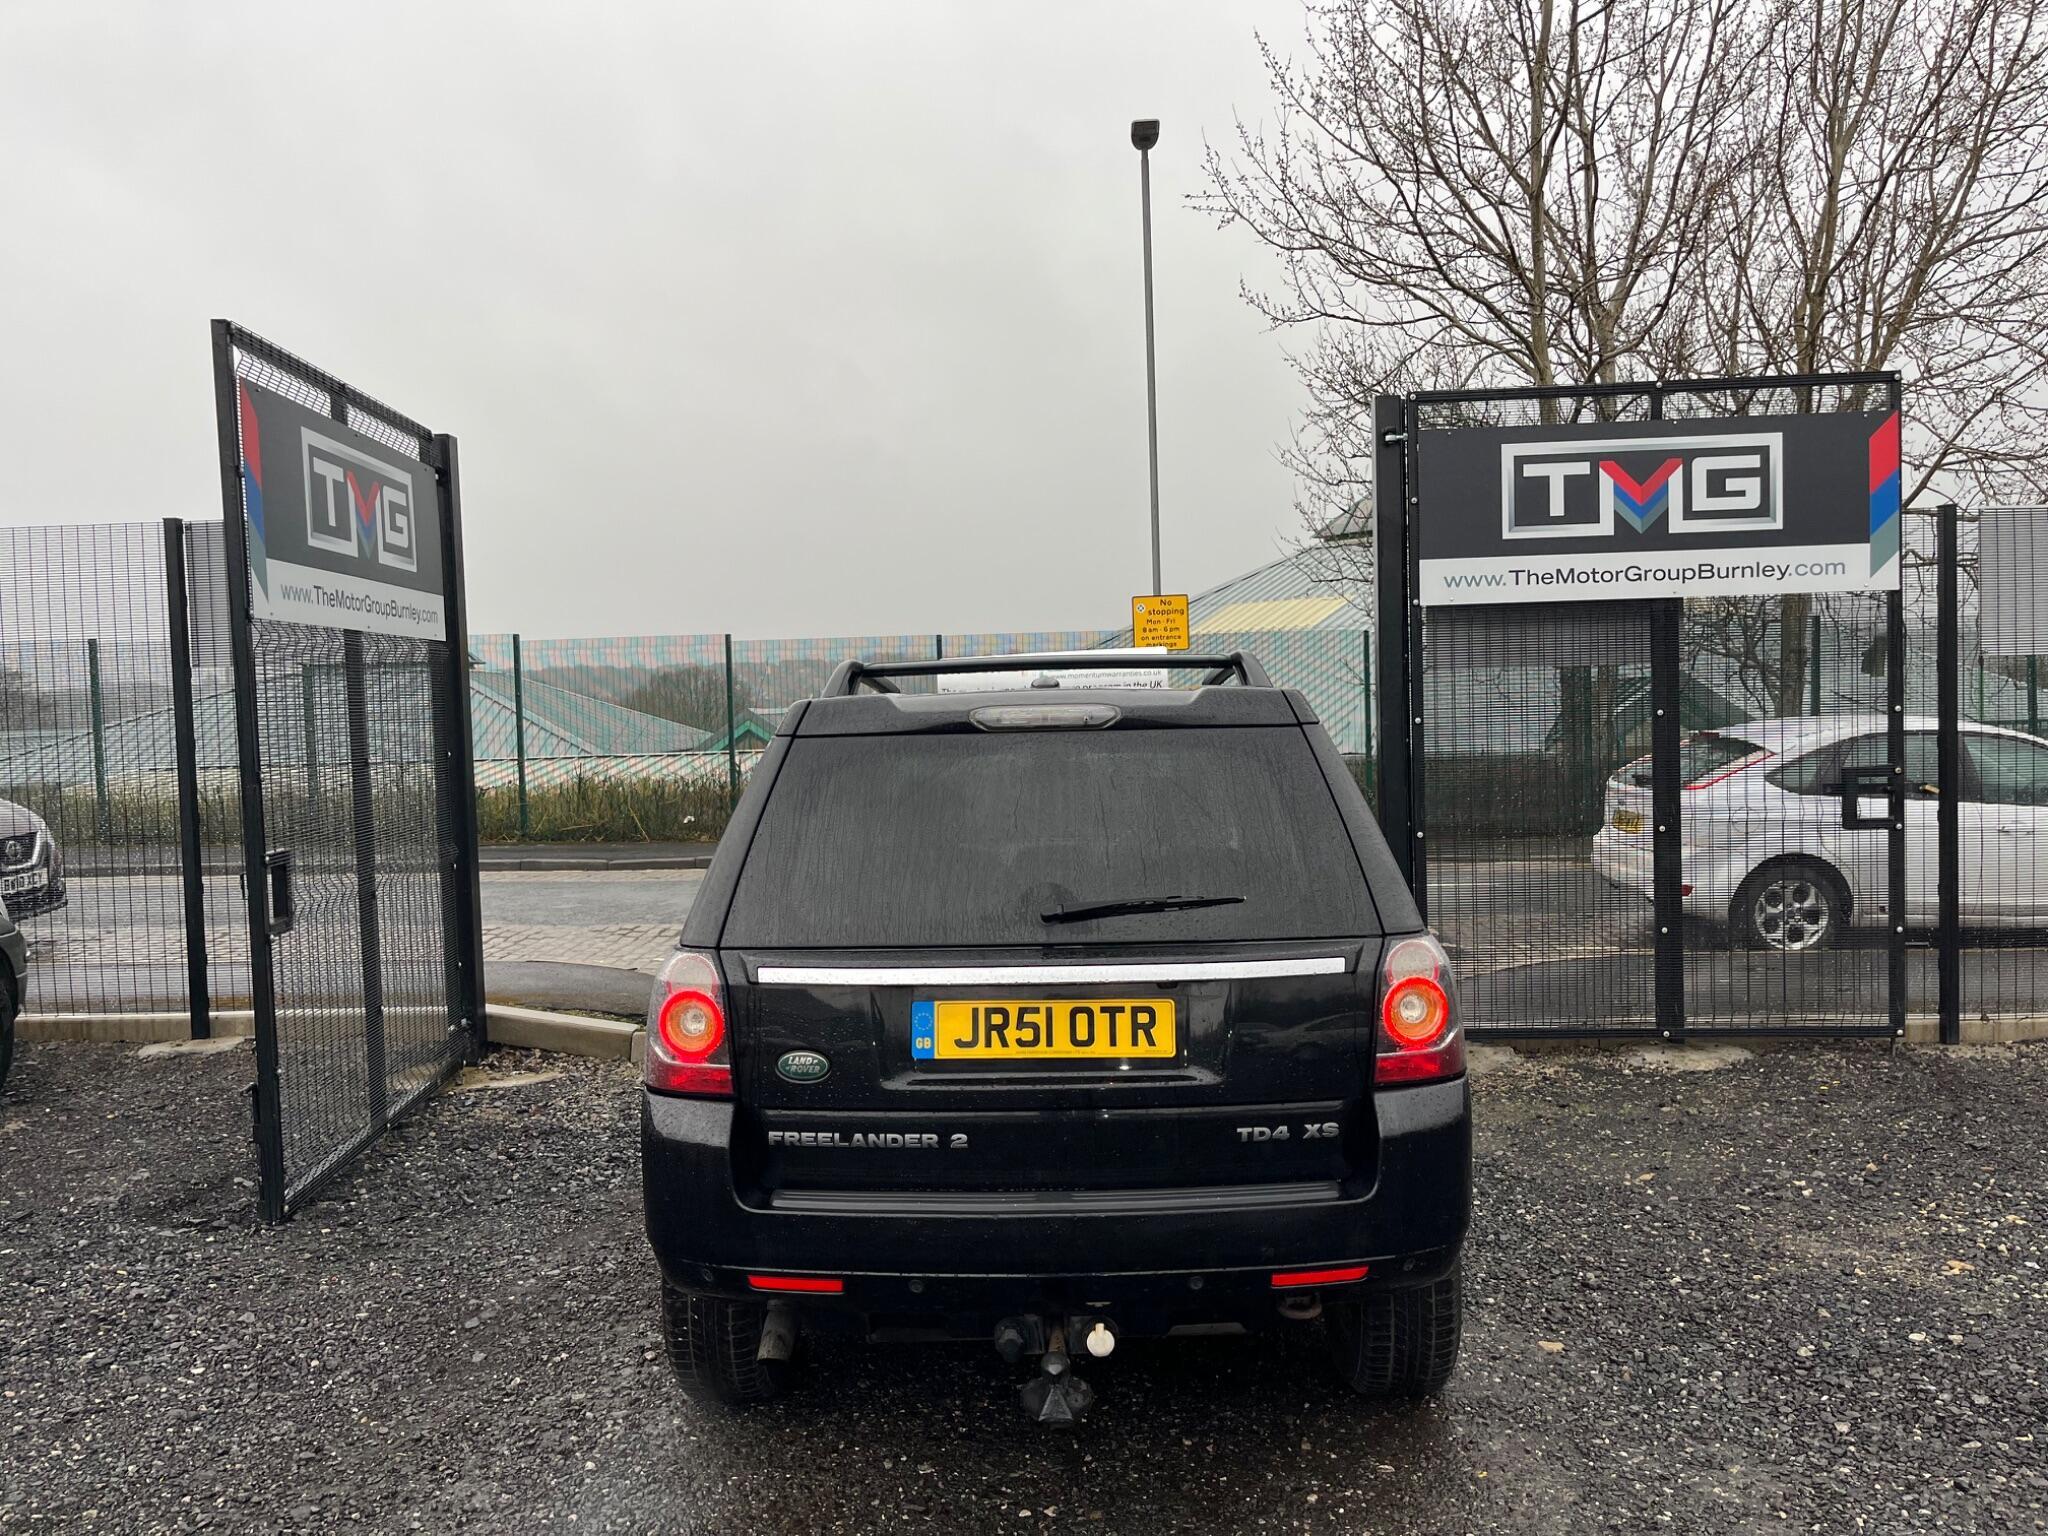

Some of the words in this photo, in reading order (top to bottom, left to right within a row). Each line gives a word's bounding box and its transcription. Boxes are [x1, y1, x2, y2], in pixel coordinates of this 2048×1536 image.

[1519, 450, 1764, 536] TMG
[311, 454, 409, 562] TMG
[1443, 561, 1847, 588] www.TheMotorGroupBurnley.com
[280, 583, 439, 624] www.TheMotorGroupBurnley.com
[1147, 608, 1185, 616] stopping
[1053, 669, 1161, 680] ww.momentumwarranties.co.uk
[1149, 680, 1163, 688] UK
[953, 1006, 1053, 1049] JR51
[1069, 1006, 1157, 1048] OTR
[915, 1037, 932, 1049] GB
[788, 1056, 813, 1065] LAND
[790, 1064, 820, 1073] ROVER
[768, 1131, 939, 1148] FREELANDER
[950, 1133, 969, 1148] 2
[1236, 1125, 1291, 1142] TD4
[1302, 1122, 1340, 1139] XS
